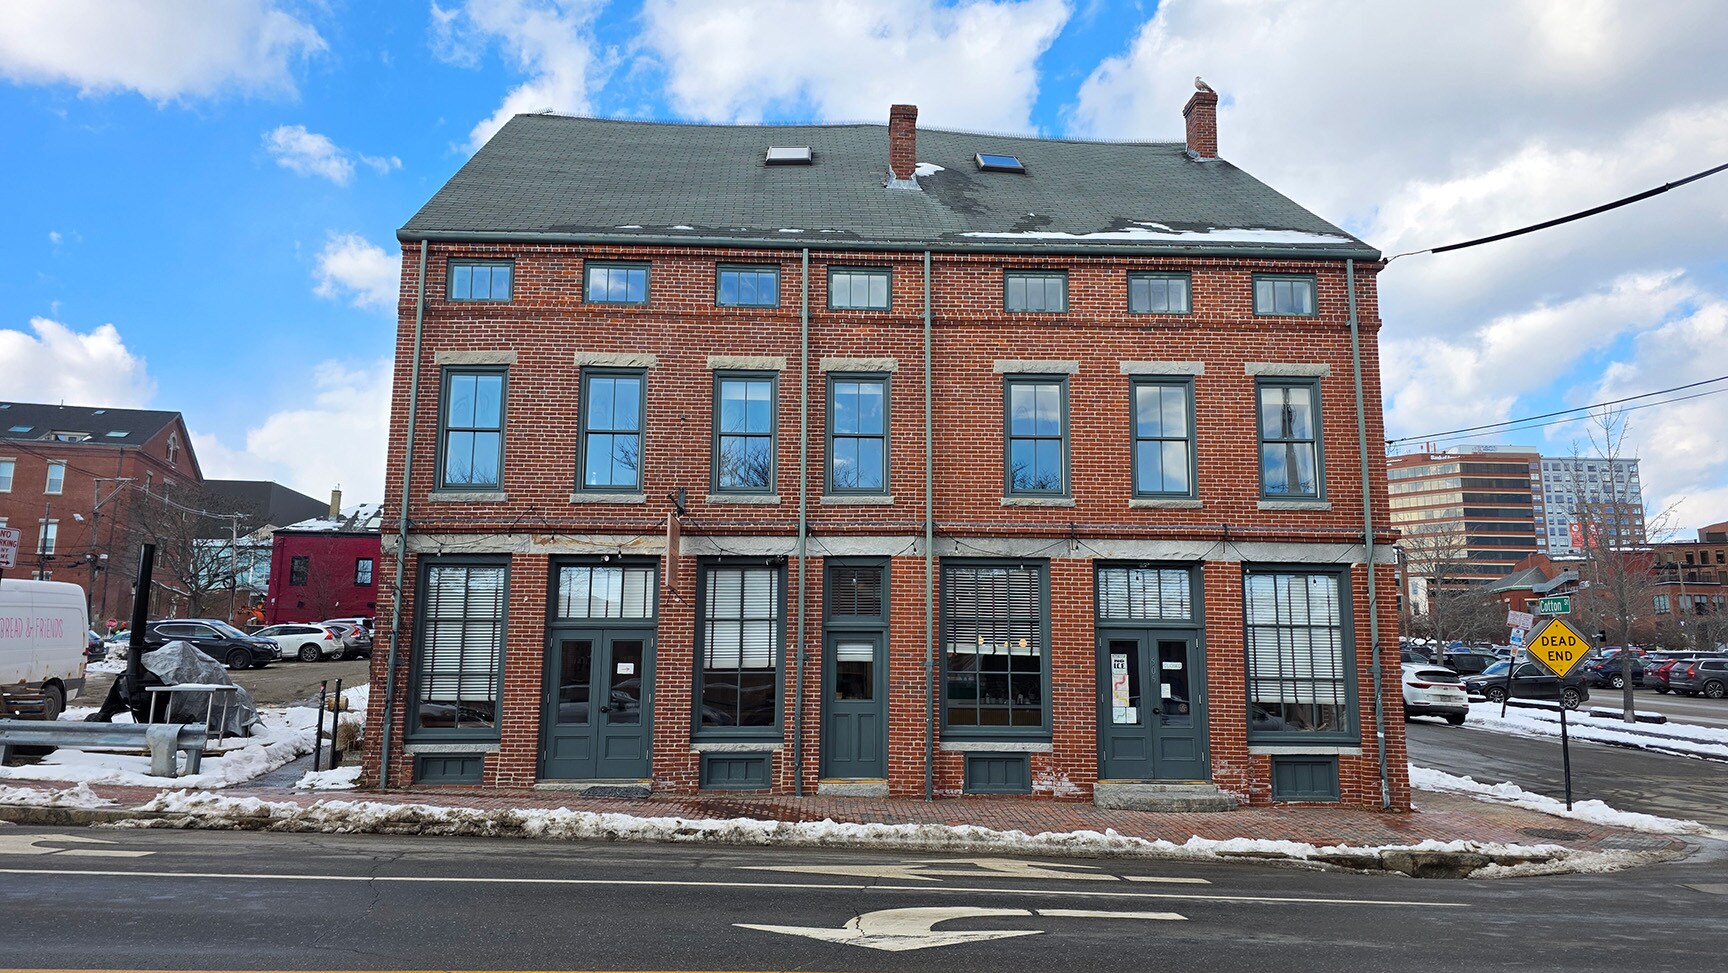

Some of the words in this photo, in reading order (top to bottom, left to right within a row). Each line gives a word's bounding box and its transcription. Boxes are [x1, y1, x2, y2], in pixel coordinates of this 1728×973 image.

[0, 530, 11, 538] NO
[0, 540, 17, 548] RKING
[1540, 600, 1562, 612] Cotton
[26, 618, 33, 638] &
[1541, 636, 1576, 647] DEAD
[1547, 651, 1573, 661] END
